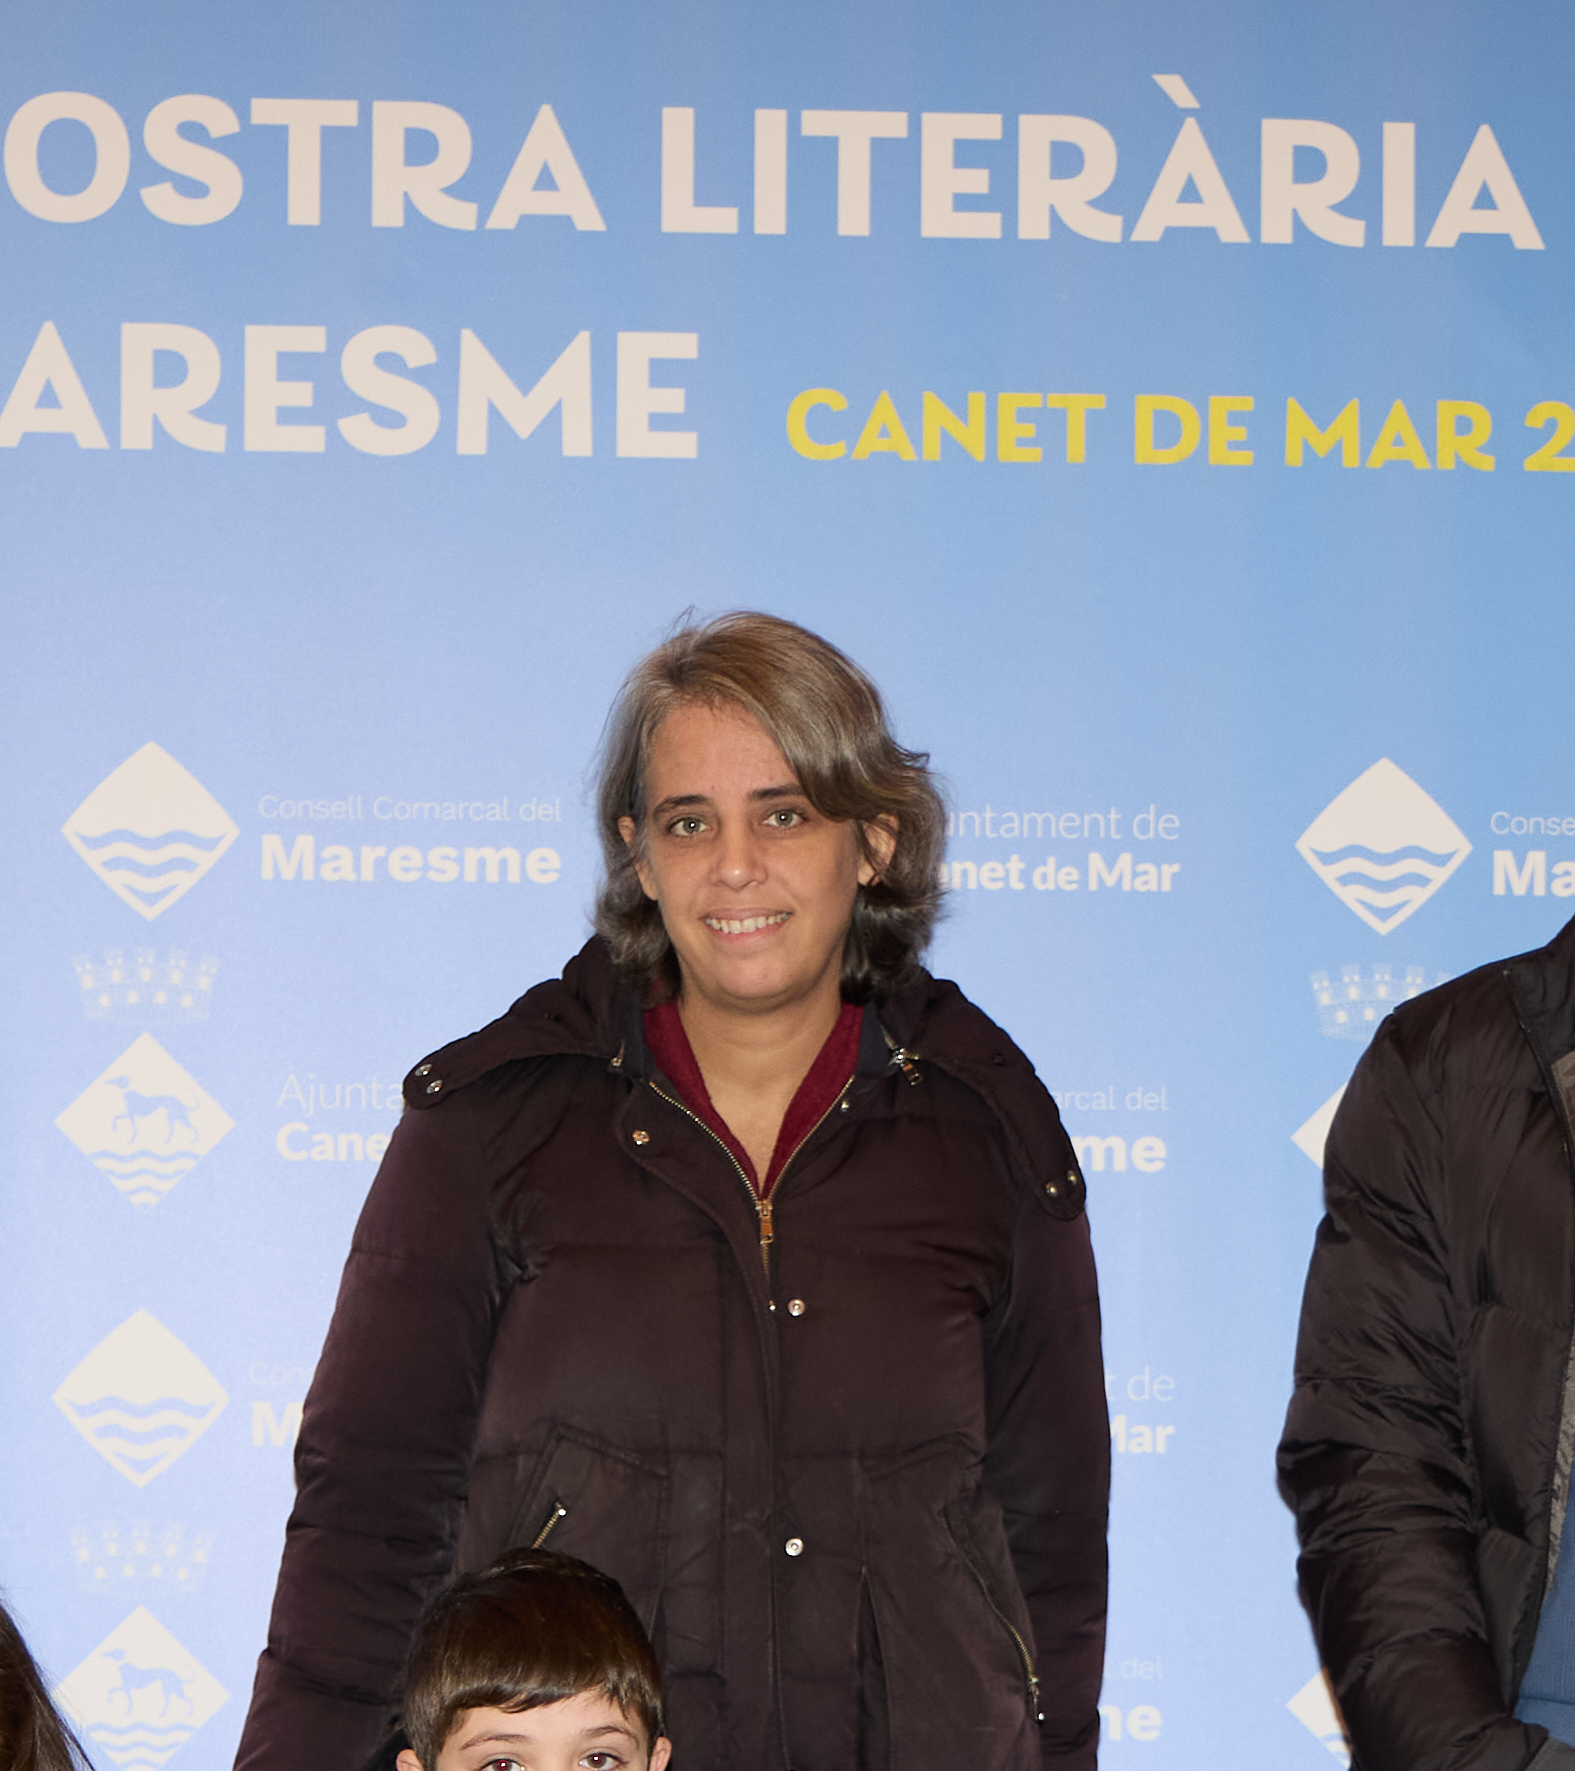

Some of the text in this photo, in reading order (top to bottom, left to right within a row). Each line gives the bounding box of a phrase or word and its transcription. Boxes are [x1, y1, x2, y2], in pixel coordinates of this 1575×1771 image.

[661, 74, 1544, 249] LITERÀRIA
[784, 387, 1108, 464] CANET
[1133, 394, 1256, 468] DE
[1284, 397, 1496, 473] MAR
[258, 794, 561, 822] Consell Comarcal del
[1132, 804, 1180, 840] de
[262, 834, 561, 883] Maresme
[1033, 852, 1180, 891] de Mar
[1126, 1086, 1168, 1111] del
[1128, 1365, 1176, 1402] de
[1122, 1656, 1162, 1680] del
